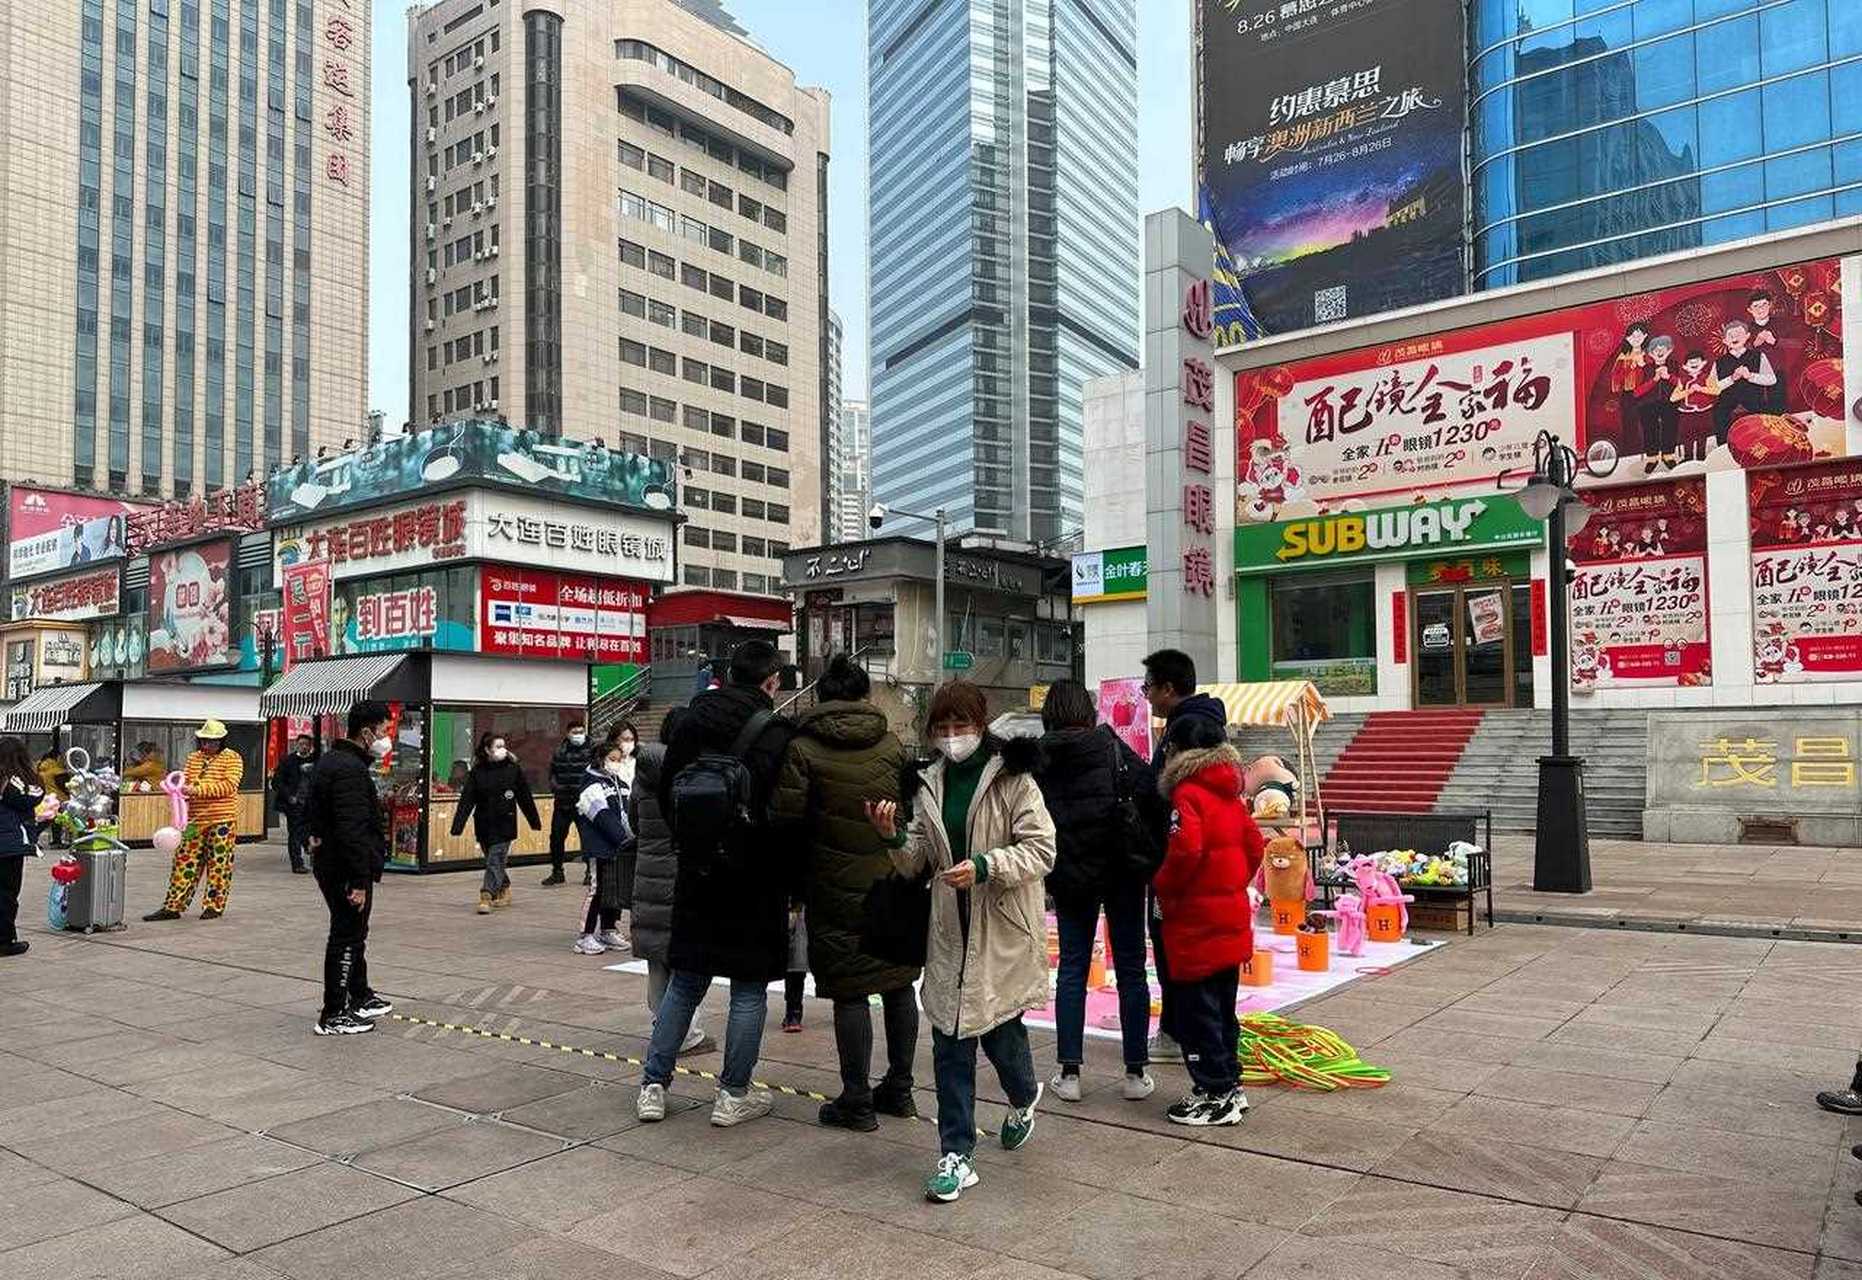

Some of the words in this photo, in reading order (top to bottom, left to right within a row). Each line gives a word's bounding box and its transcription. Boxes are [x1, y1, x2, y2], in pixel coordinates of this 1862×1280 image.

[1237, 10, 1276, 34] 8.26
[1269, 65, 1382, 127] 约惠慕思
[1304, 356, 1551, 444] 配镜全家福
[1342, 445, 1370, 462] 全家
[1433, 421, 1489, 447] 1230
[1183, 357, 1215, 598] 茂昌眼镜
[488, 512, 667, 561] 大连百姓眼镜城
[1275, 500, 1487, 562] SUBWAY
[560, 585, 642, 607] 全场超低折扣
[1572, 567, 1700, 600] 配镜全家福
[1646, 594, 1689, 612] 1230
[357, 588, 436, 640] 到百姓
[1696, 736, 1856, 788] 茂昌
[1378, 918, 1390, 931] H
